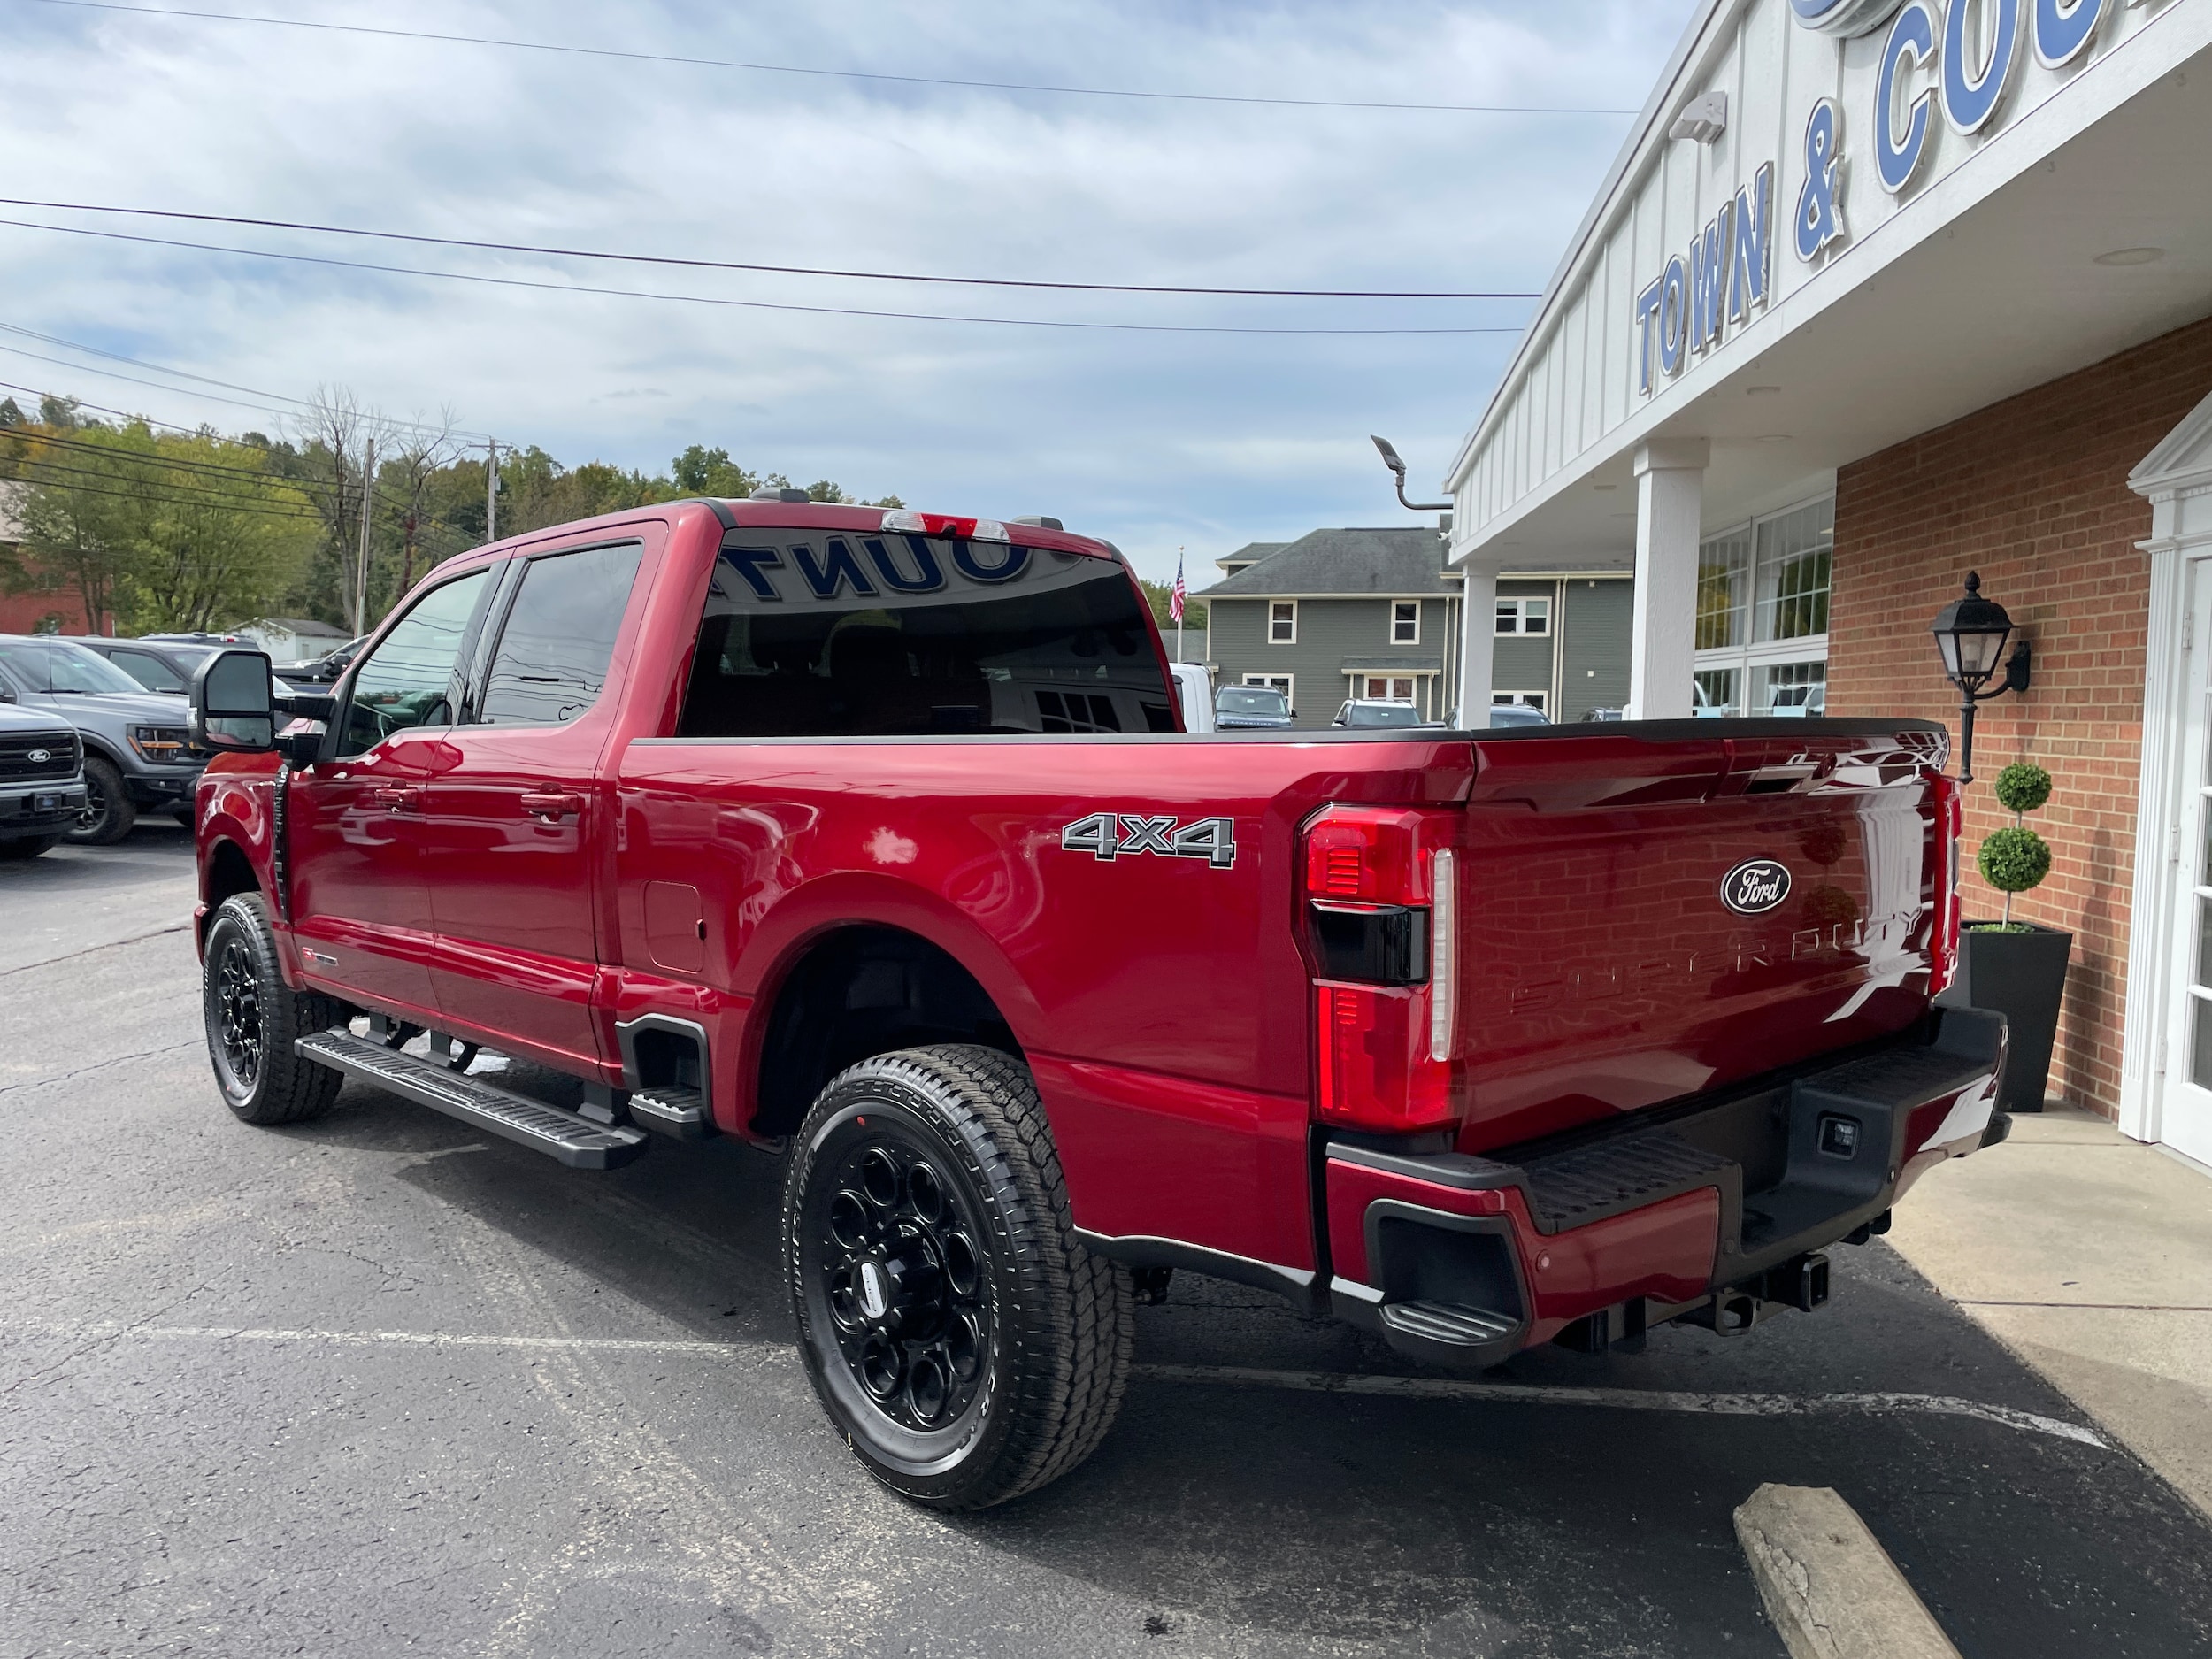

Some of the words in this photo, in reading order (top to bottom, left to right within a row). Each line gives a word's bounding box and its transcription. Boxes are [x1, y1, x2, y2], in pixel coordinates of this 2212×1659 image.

[1637, 161, 1773, 396] TOWN
[1794, 96, 1844, 263] &
[1737, 868, 1781, 905] Ford
[1792, 905, 1924, 961] DUTY
